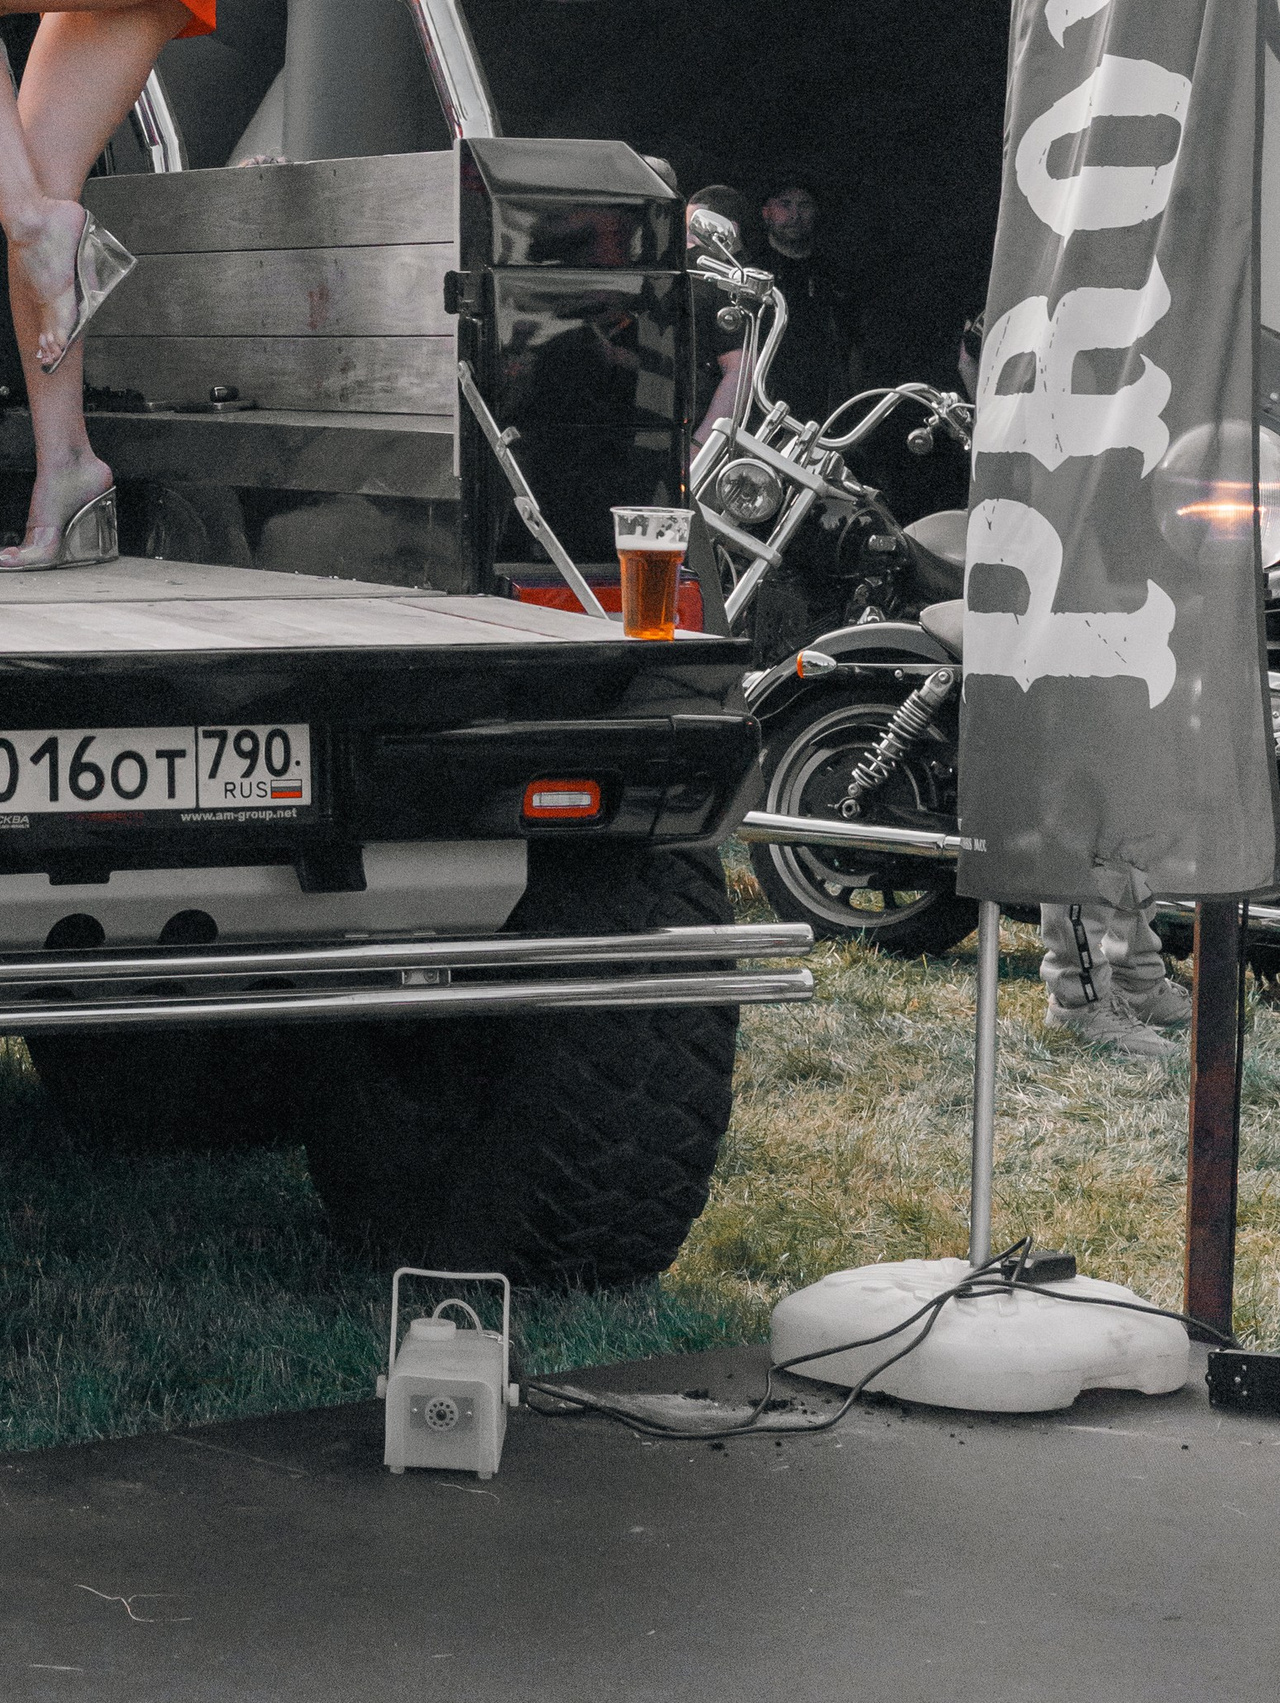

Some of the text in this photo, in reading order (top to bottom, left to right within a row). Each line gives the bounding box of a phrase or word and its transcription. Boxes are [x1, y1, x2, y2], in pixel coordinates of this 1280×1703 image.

[201, 728, 292, 780] 790
[224, 781, 268, 799] RUS
[180, 807, 298, 822] www.am-group.net
